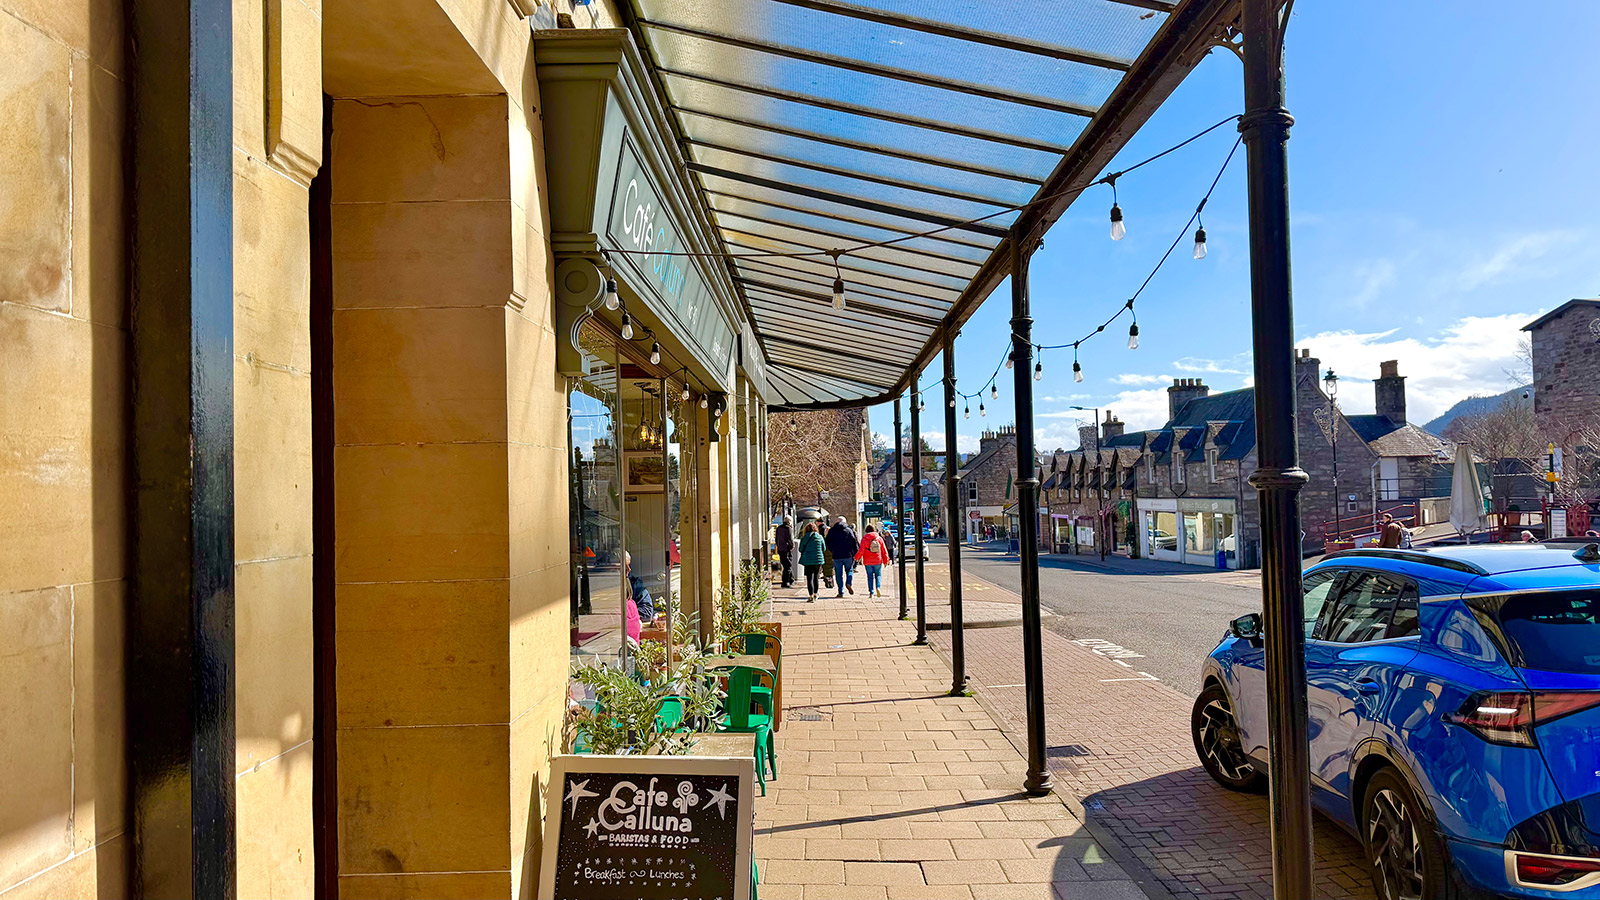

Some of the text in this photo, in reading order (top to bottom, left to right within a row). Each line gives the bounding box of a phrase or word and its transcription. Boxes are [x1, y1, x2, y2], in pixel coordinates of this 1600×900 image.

[623, 178, 655, 260] Café
[610, 777, 668, 814] Cafe
[598, 797, 693, 832] Calluna
[609, 833, 690, 844] BARISTAS & FOOD
[584, 867, 685, 884] Breakfast Lunches
